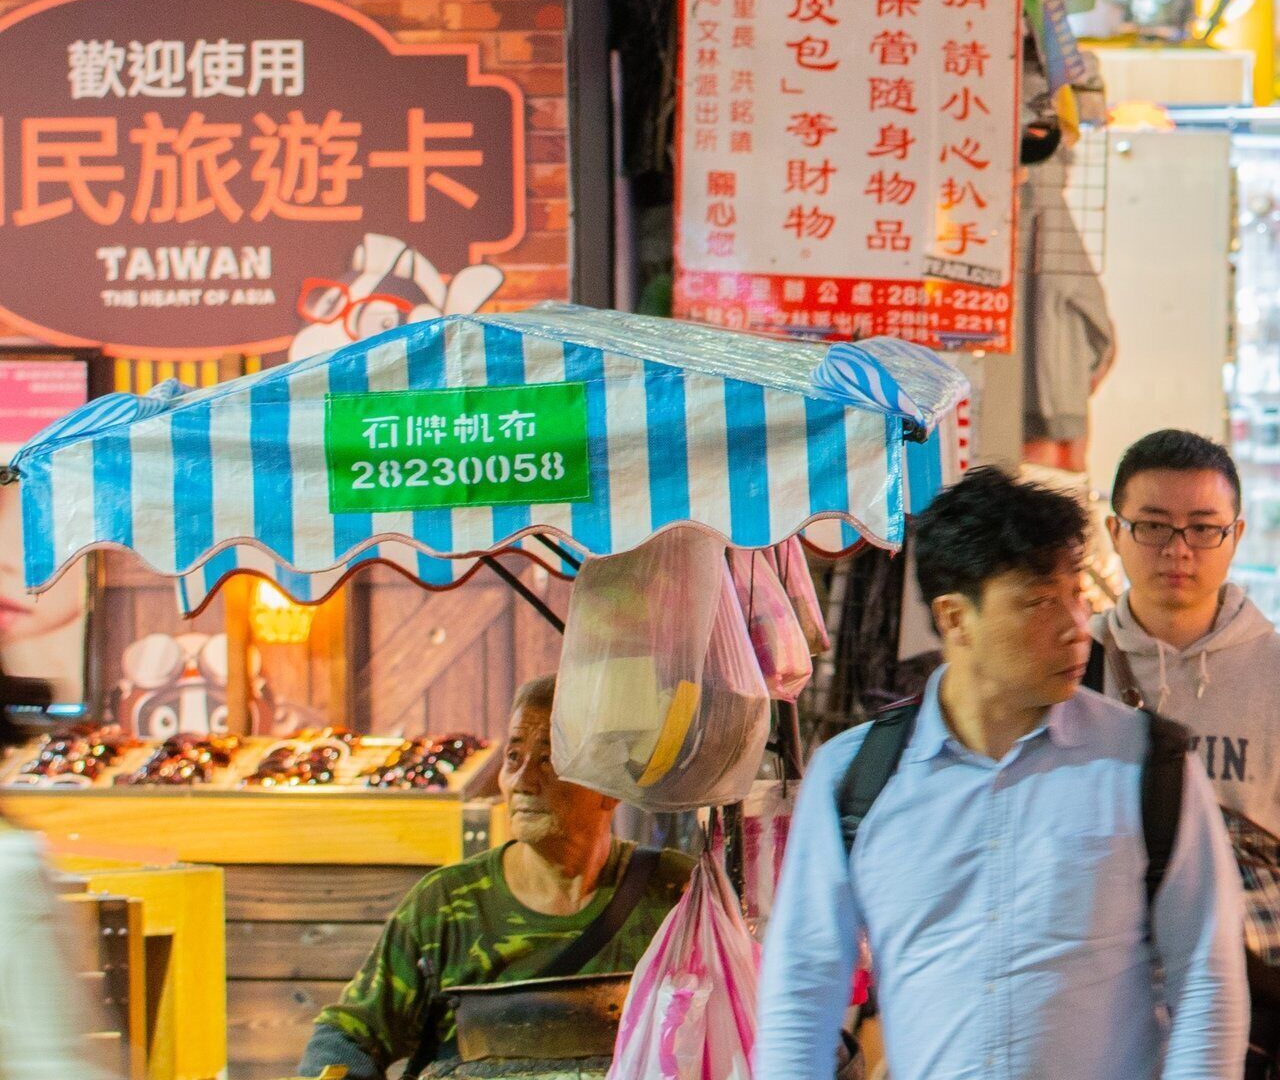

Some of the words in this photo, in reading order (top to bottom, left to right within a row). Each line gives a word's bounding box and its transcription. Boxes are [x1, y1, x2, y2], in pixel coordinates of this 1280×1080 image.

[67, 38, 305, 100] 歡迎使用
[0, 108, 484, 225] 民旅遊卡
[95, 245, 273, 282] TAIWAN
[139, 289, 202, 307] HEART
[230, 288, 276, 306] ASIA
[361, 409, 536, 449] 石牌帆布
[350, 451, 566, 490] 28230058
